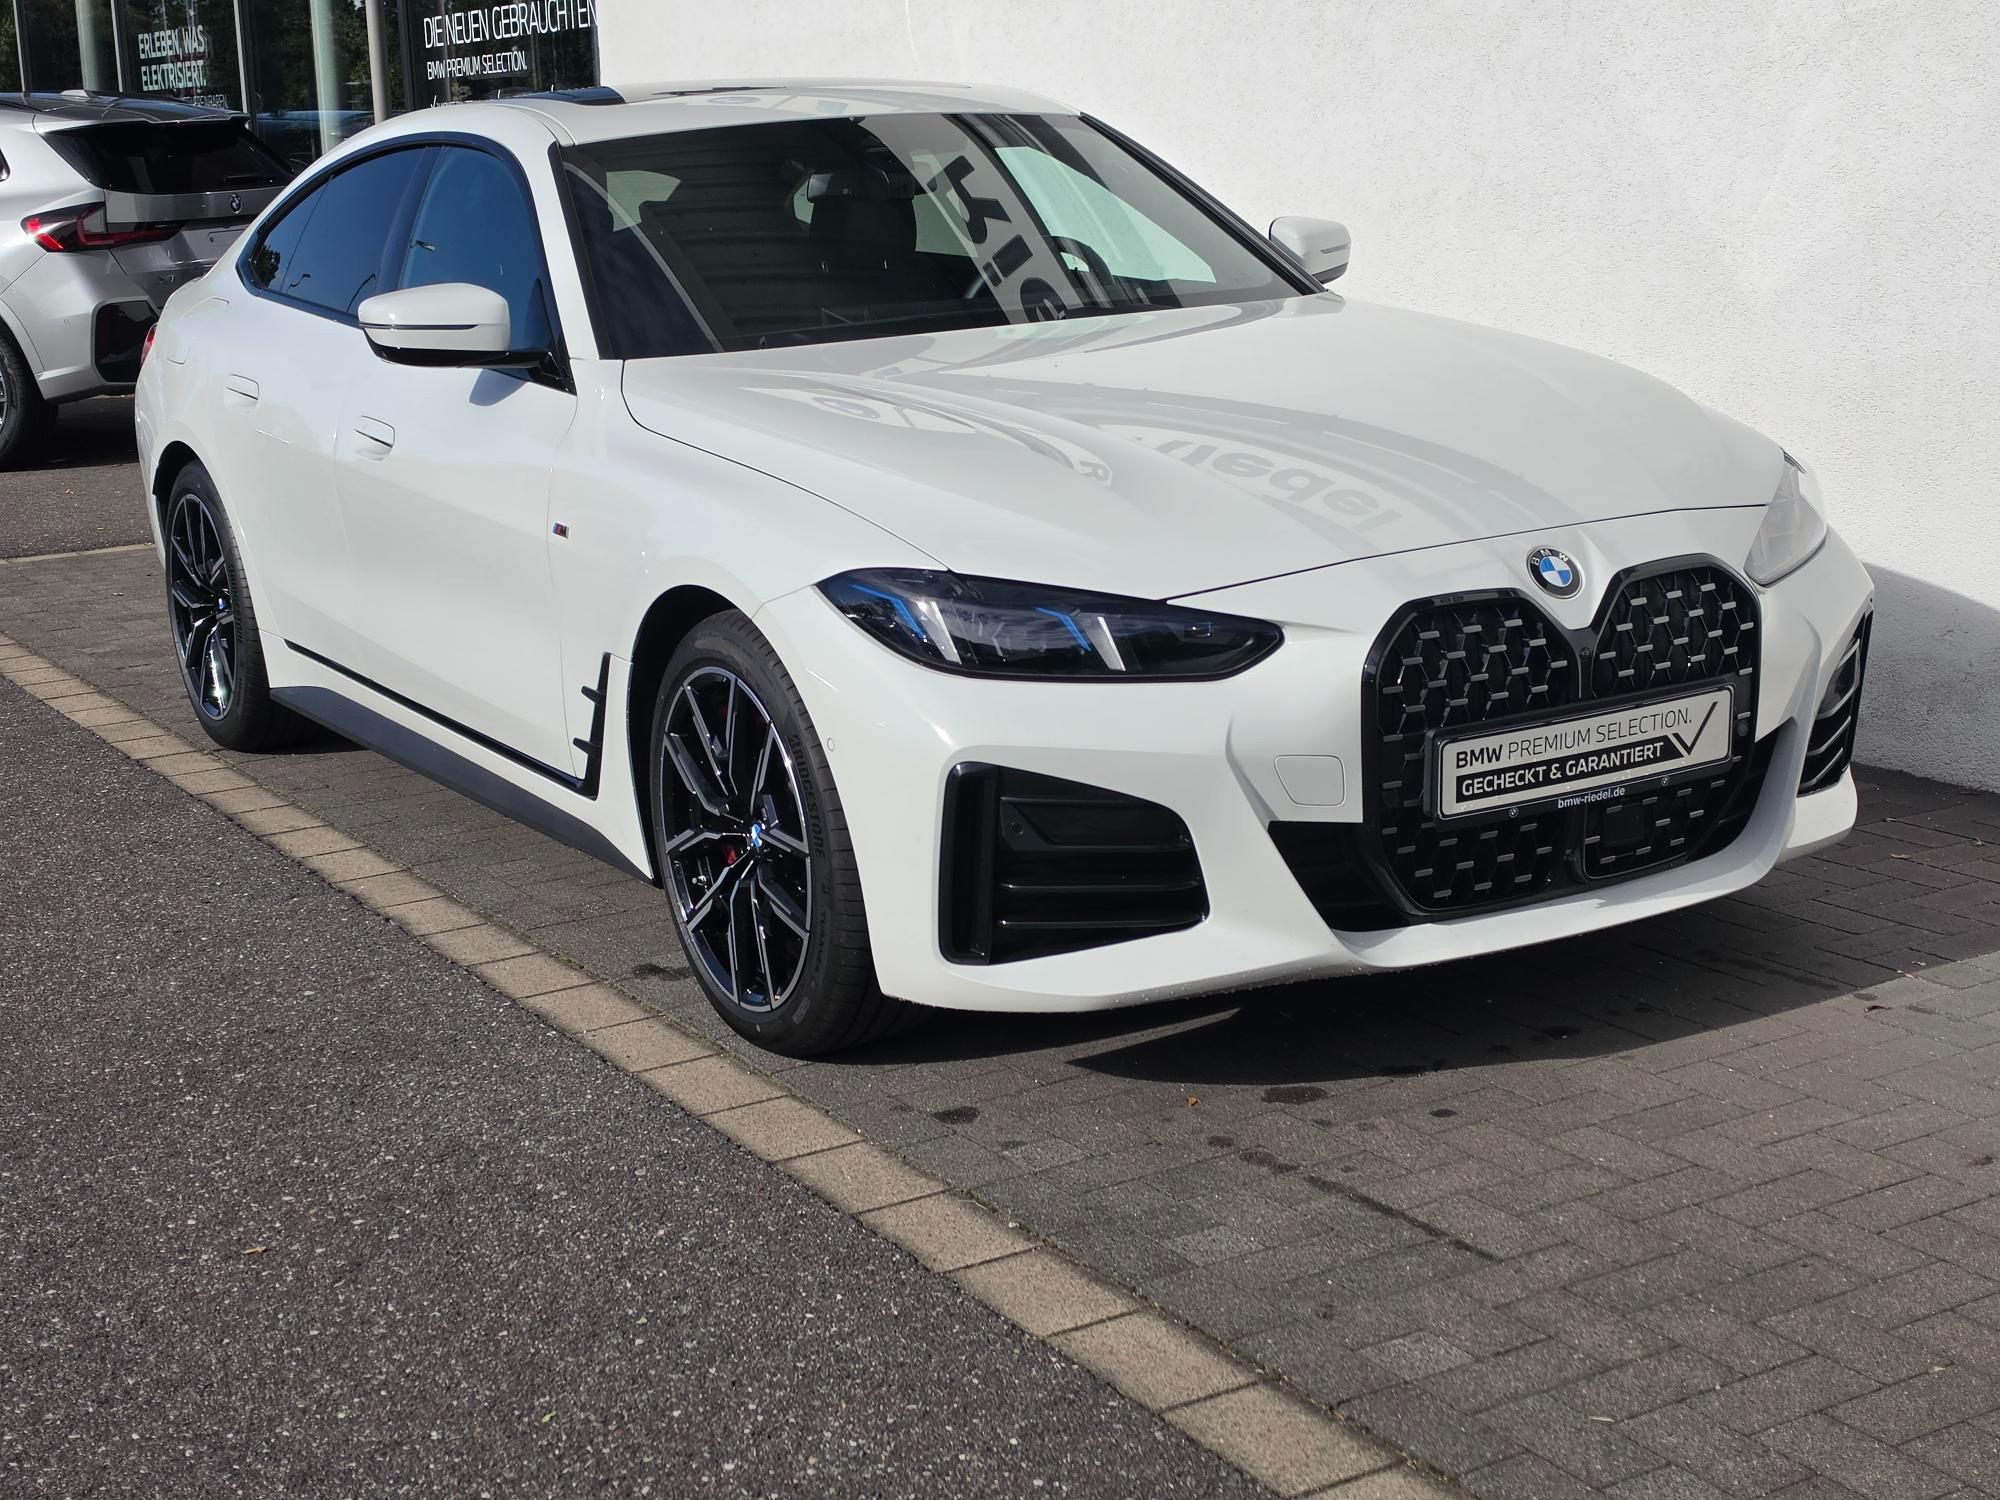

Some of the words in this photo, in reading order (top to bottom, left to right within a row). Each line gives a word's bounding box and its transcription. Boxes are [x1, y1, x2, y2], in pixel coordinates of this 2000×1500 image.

[138, 29, 183, 60] ERLEBEN,
[182, 25, 205, 54] WAS
[423, 16, 445, 49] DIE
[445, 8, 490, 46] NEUEN
[141, 60, 207, 91] ELEKTRISIERT.
[427, 60, 446, 80] BMW
[447, 56, 481, 78] PREMIUM
[482, 50, 528, 74] SELECTION.
[1531, 549, 1569, 566] BMW
[1456, 744, 1504, 770] BMW
[1508, 728, 1591, 760] PREMIUM
[1596, 708, 1692, 743] SELECTION.
[1462, 765, 1547, 796] GECHECKT
[1550, 763, 1562, 779] &
[1566, 741, 1665, 776] GARANTIERT
[788, 734, 826, 859] BRIDGESTONE
[1557, 787, 1626, 809] bmw-riedel.de
